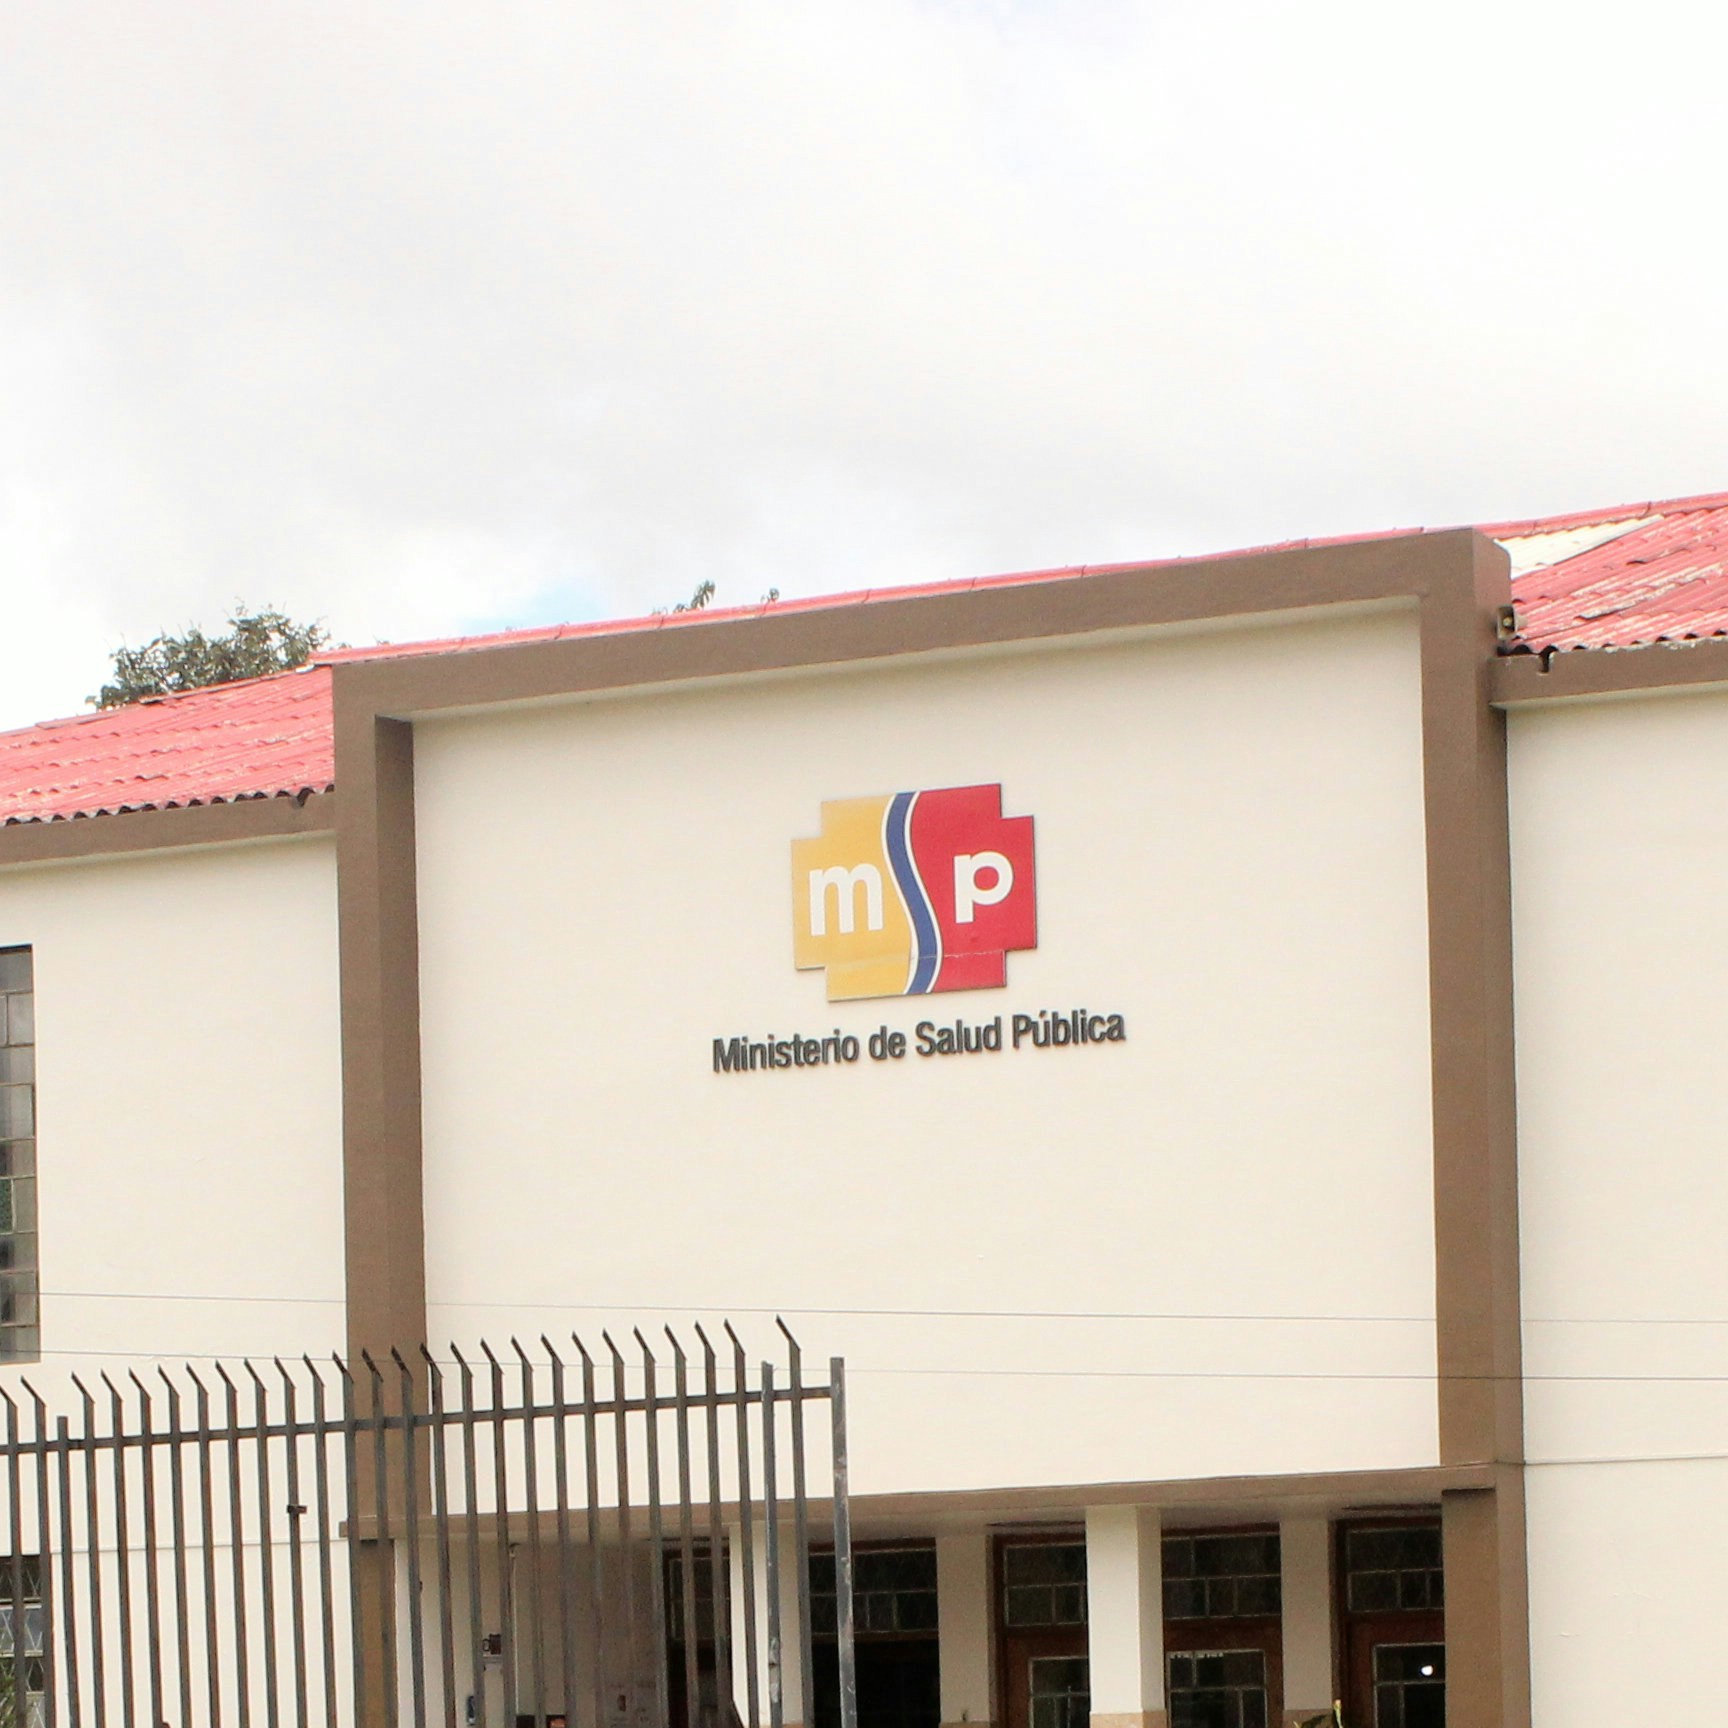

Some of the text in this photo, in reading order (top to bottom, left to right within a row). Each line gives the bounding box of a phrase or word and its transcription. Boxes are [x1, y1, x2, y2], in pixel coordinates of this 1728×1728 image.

[713, 1009, 1127, 1074] Ministerio de Salud Pública
